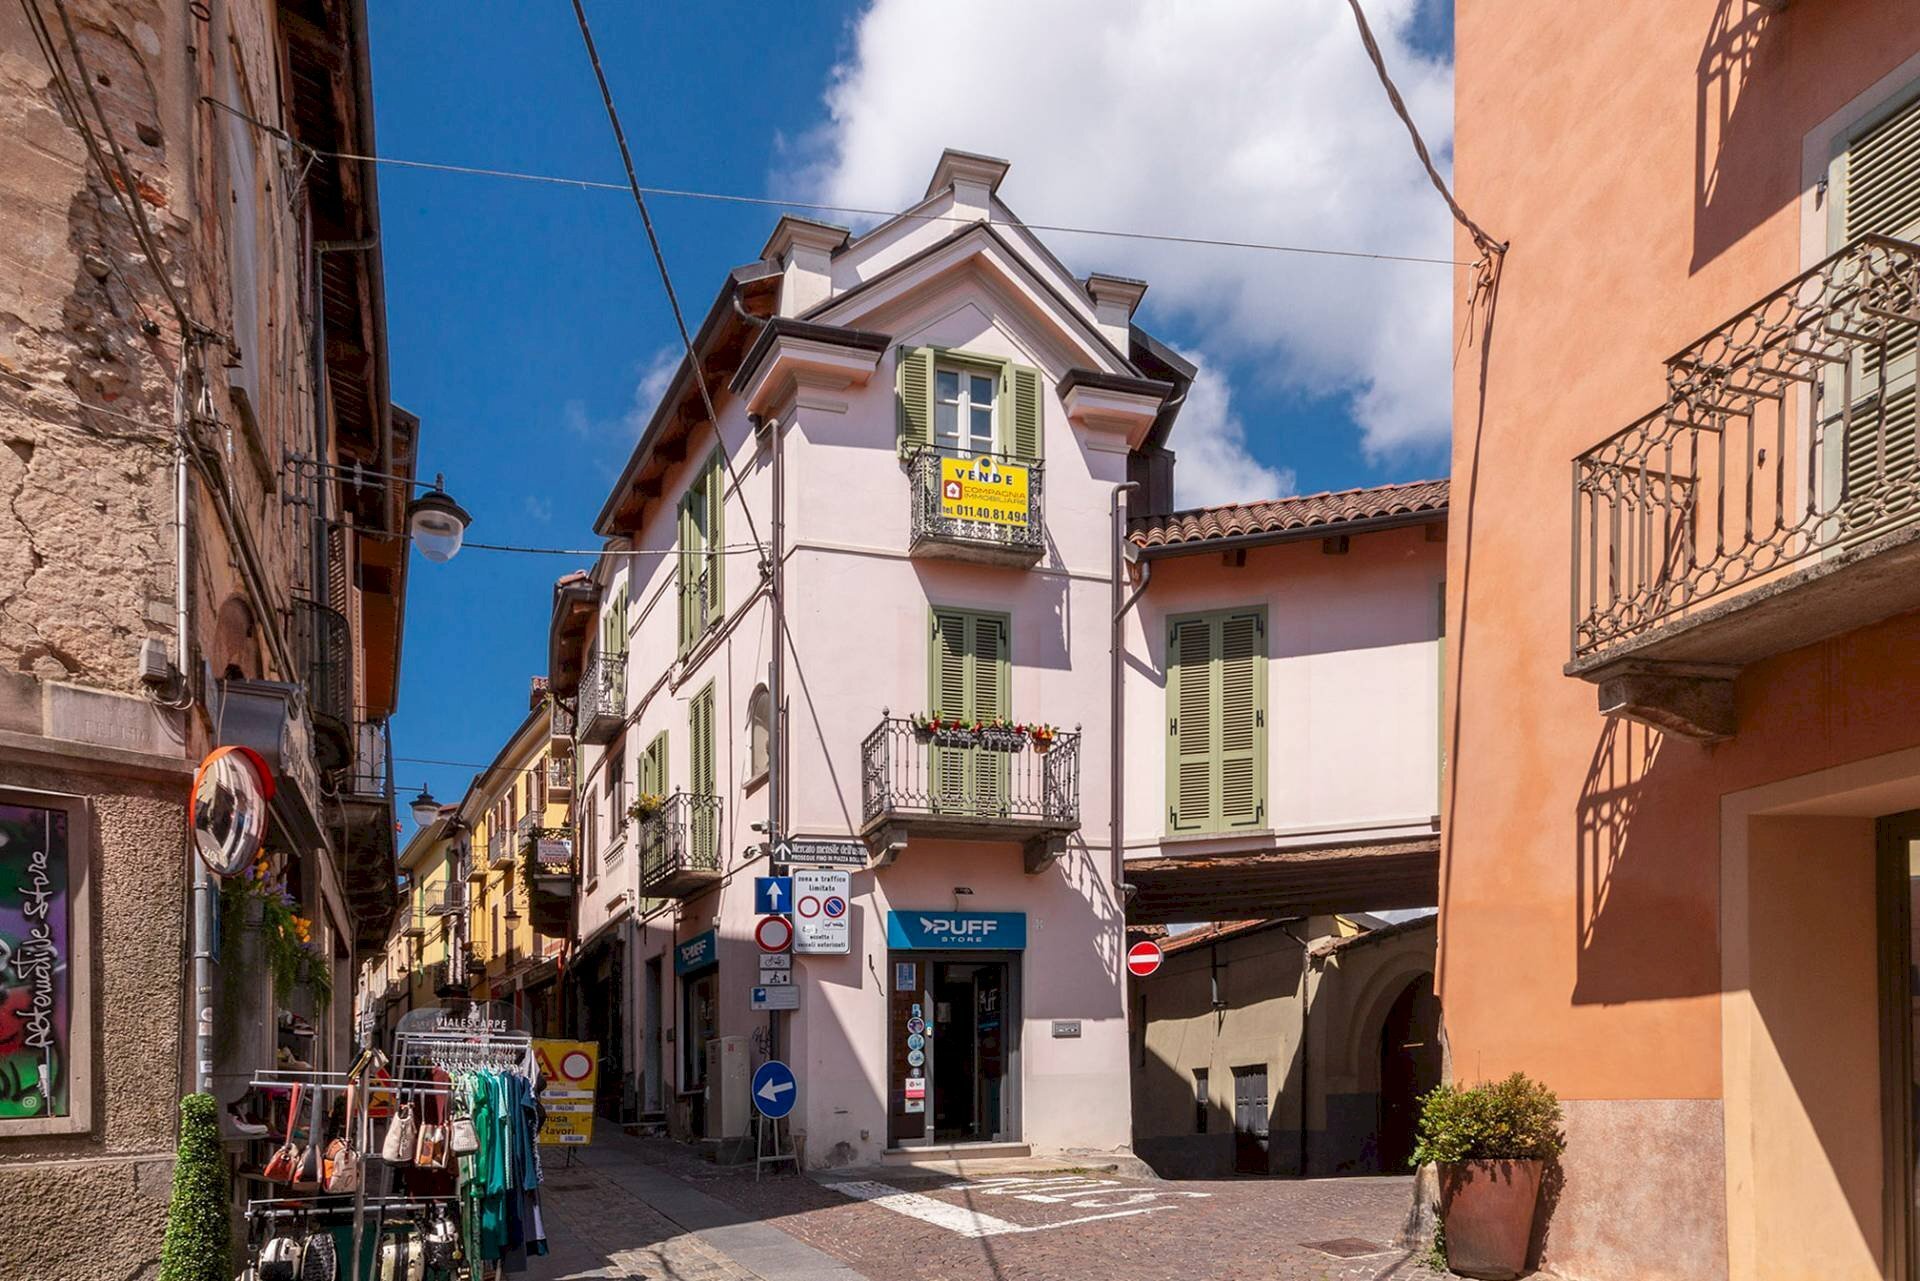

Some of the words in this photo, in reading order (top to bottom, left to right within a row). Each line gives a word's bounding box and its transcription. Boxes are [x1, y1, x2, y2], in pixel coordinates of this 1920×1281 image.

[955, 468, 1013, 485] VENDE
[964, 486, 1026, 499] COMPAGNIA
[957, 505, 1027, 522] 011.40.81.494
[18, 851, 50, 920] Store
[821, 875, 846, 883] traffico
[932, 919, 998, 935] PUFF
[545, 1126, 575, 1135] lavori
